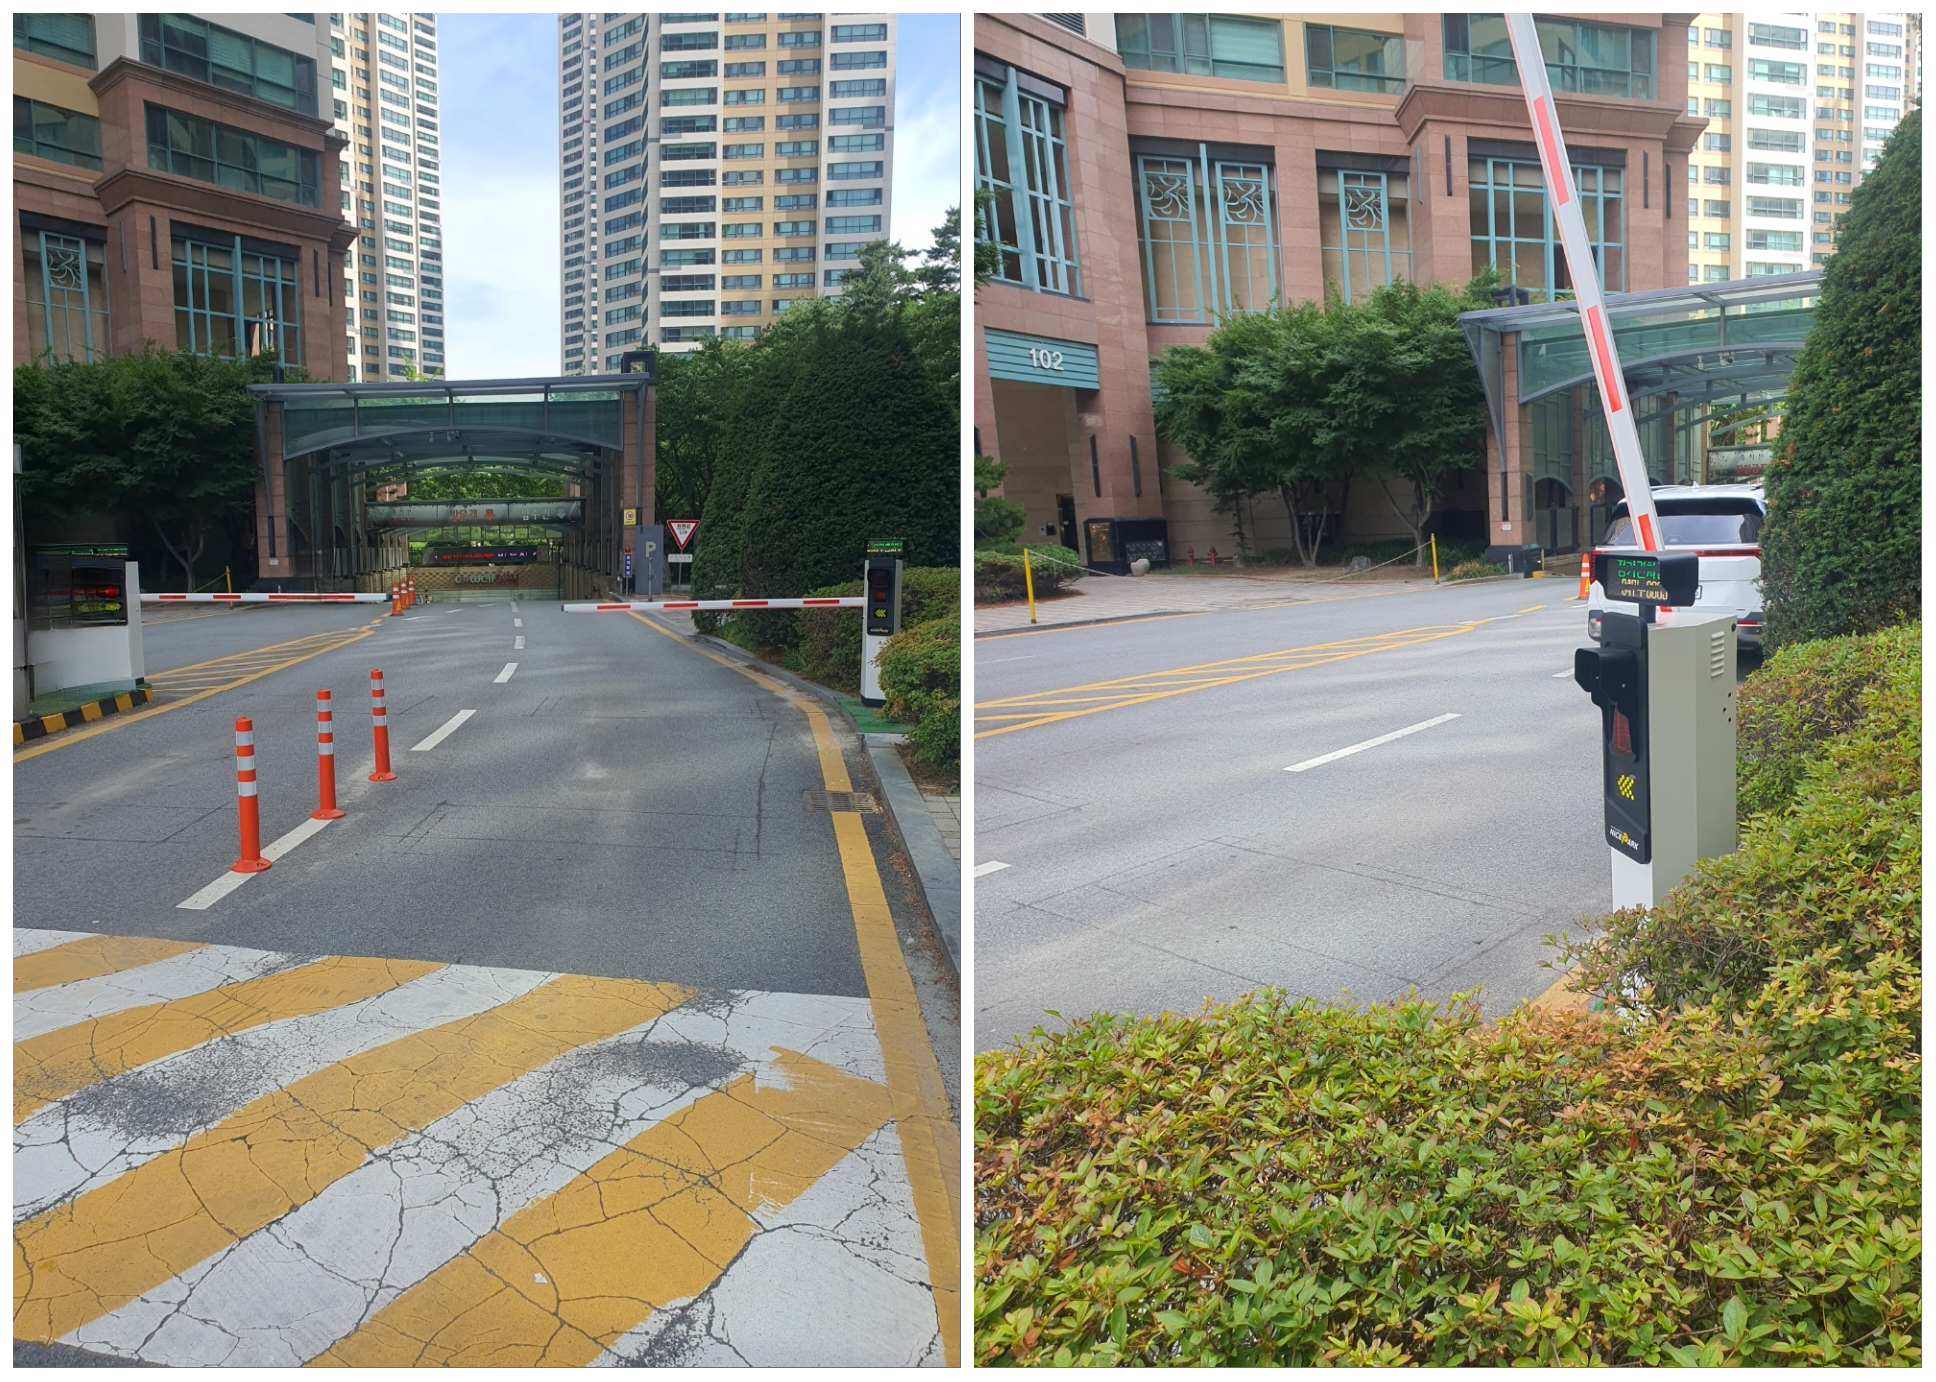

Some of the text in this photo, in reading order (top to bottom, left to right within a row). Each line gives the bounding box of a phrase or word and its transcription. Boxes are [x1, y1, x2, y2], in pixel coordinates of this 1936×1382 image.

[1029, 347, 1065, 371] 102
[449, 509, 478, 523] 방문객
[645, 541, 657, 558] P
